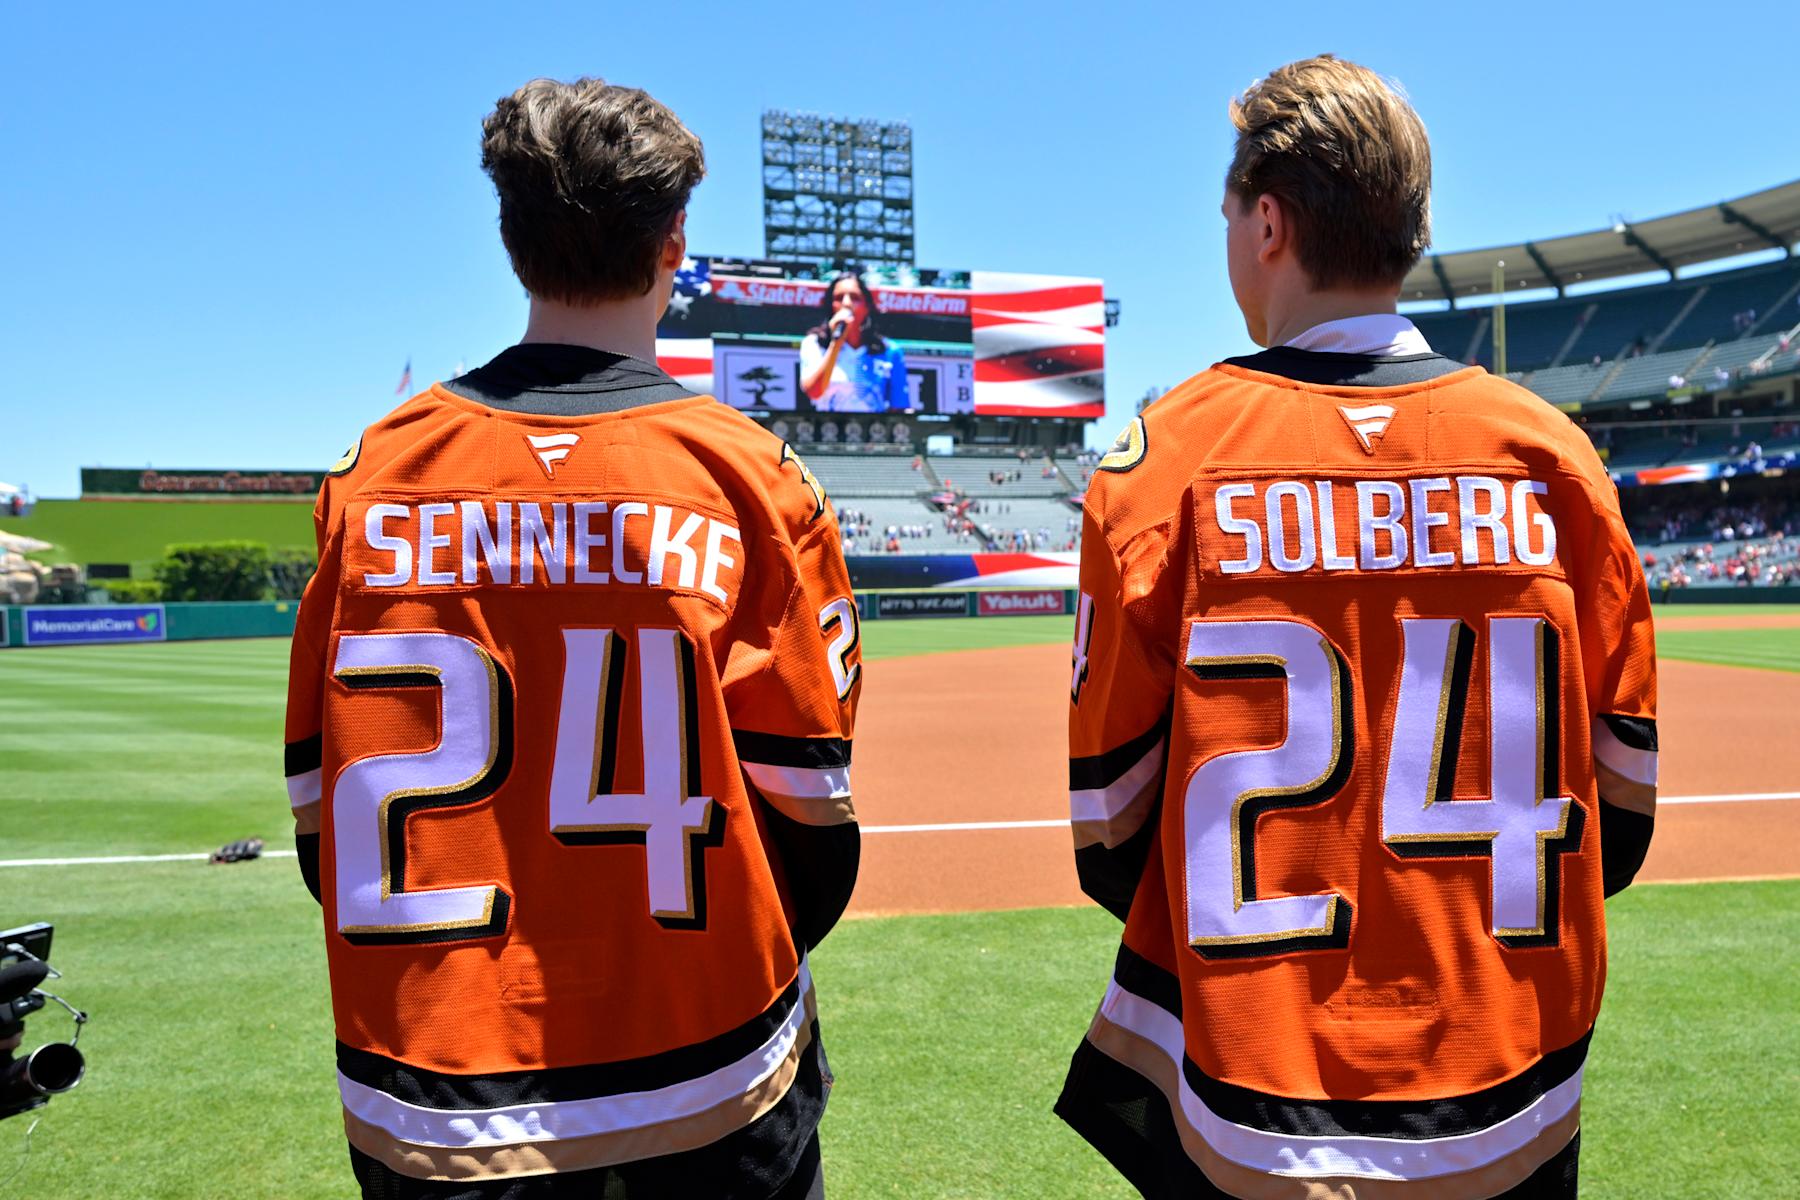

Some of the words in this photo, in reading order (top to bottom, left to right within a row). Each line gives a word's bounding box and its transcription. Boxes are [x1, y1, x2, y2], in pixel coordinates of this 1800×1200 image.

[363, 501, 740, 603] SENNECKE
[1214, 476, 1557, 575] SOLBERG
[32, 618, 135, 633] MemorialCare
[984, 594, 1059, 610] Yakult
[333, 627, 729, 947] 24
[1184, 617, 1588, 960] 24
